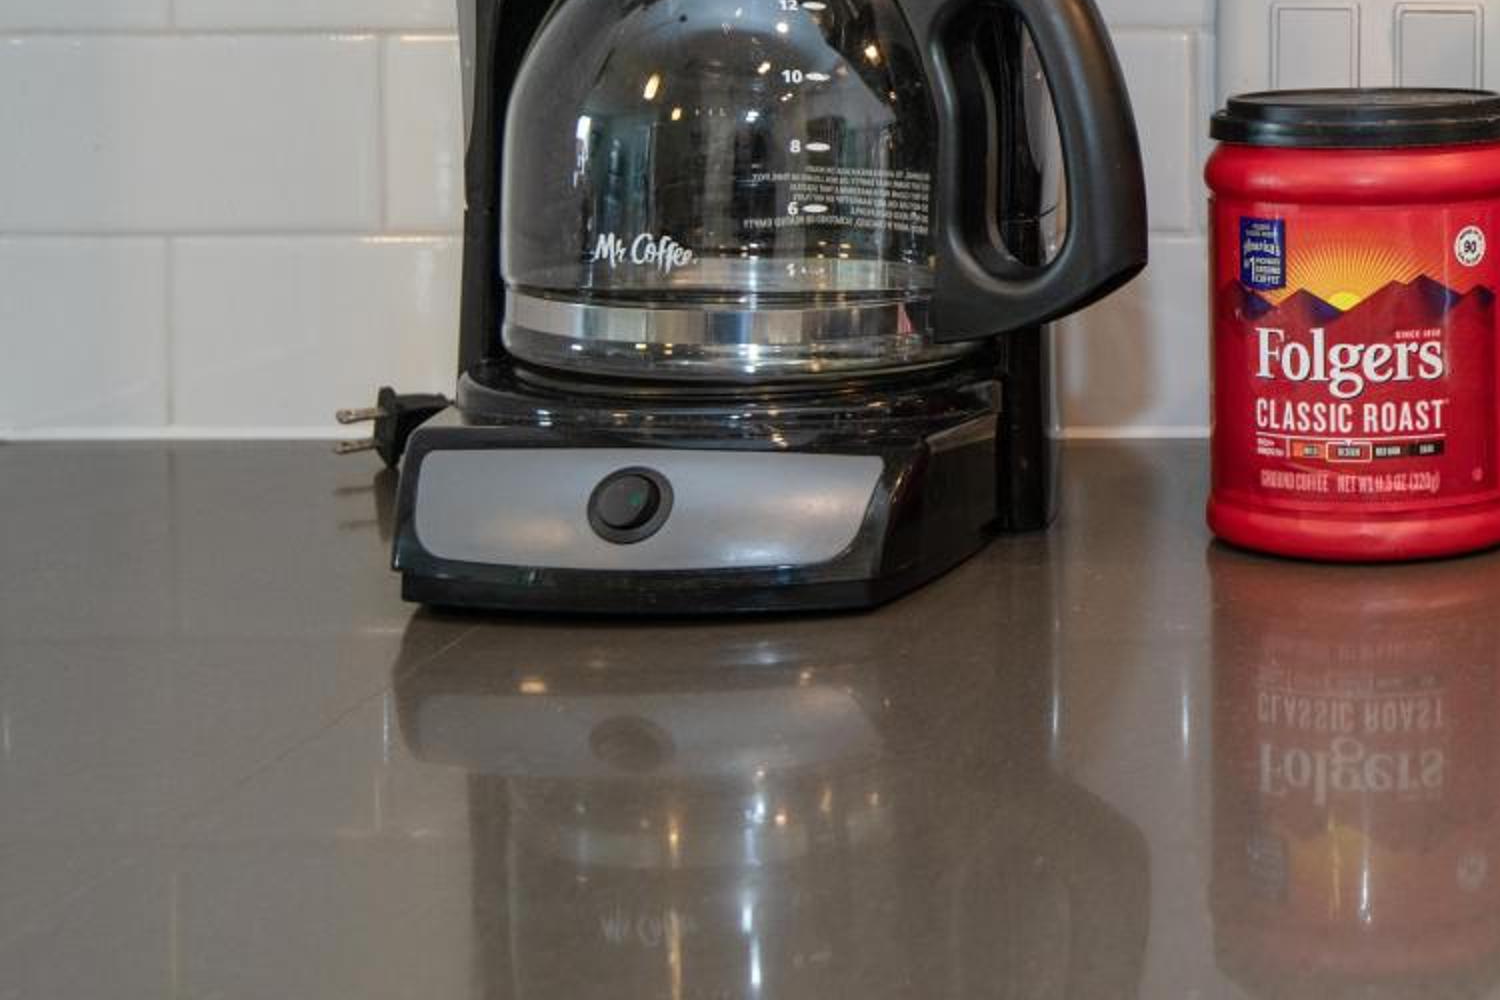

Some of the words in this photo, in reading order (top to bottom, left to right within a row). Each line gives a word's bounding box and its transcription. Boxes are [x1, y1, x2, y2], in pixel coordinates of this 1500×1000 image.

[781, 69, 803, 84] 10
[790, 139, 801, 153] 8
[787, 201, 799, 216] 6
[1255, 326, 1444, 399] Folgers
[1255, 397, 1354, 433] CLASSIC
[1362, 398, 1444, 433] ROAST
